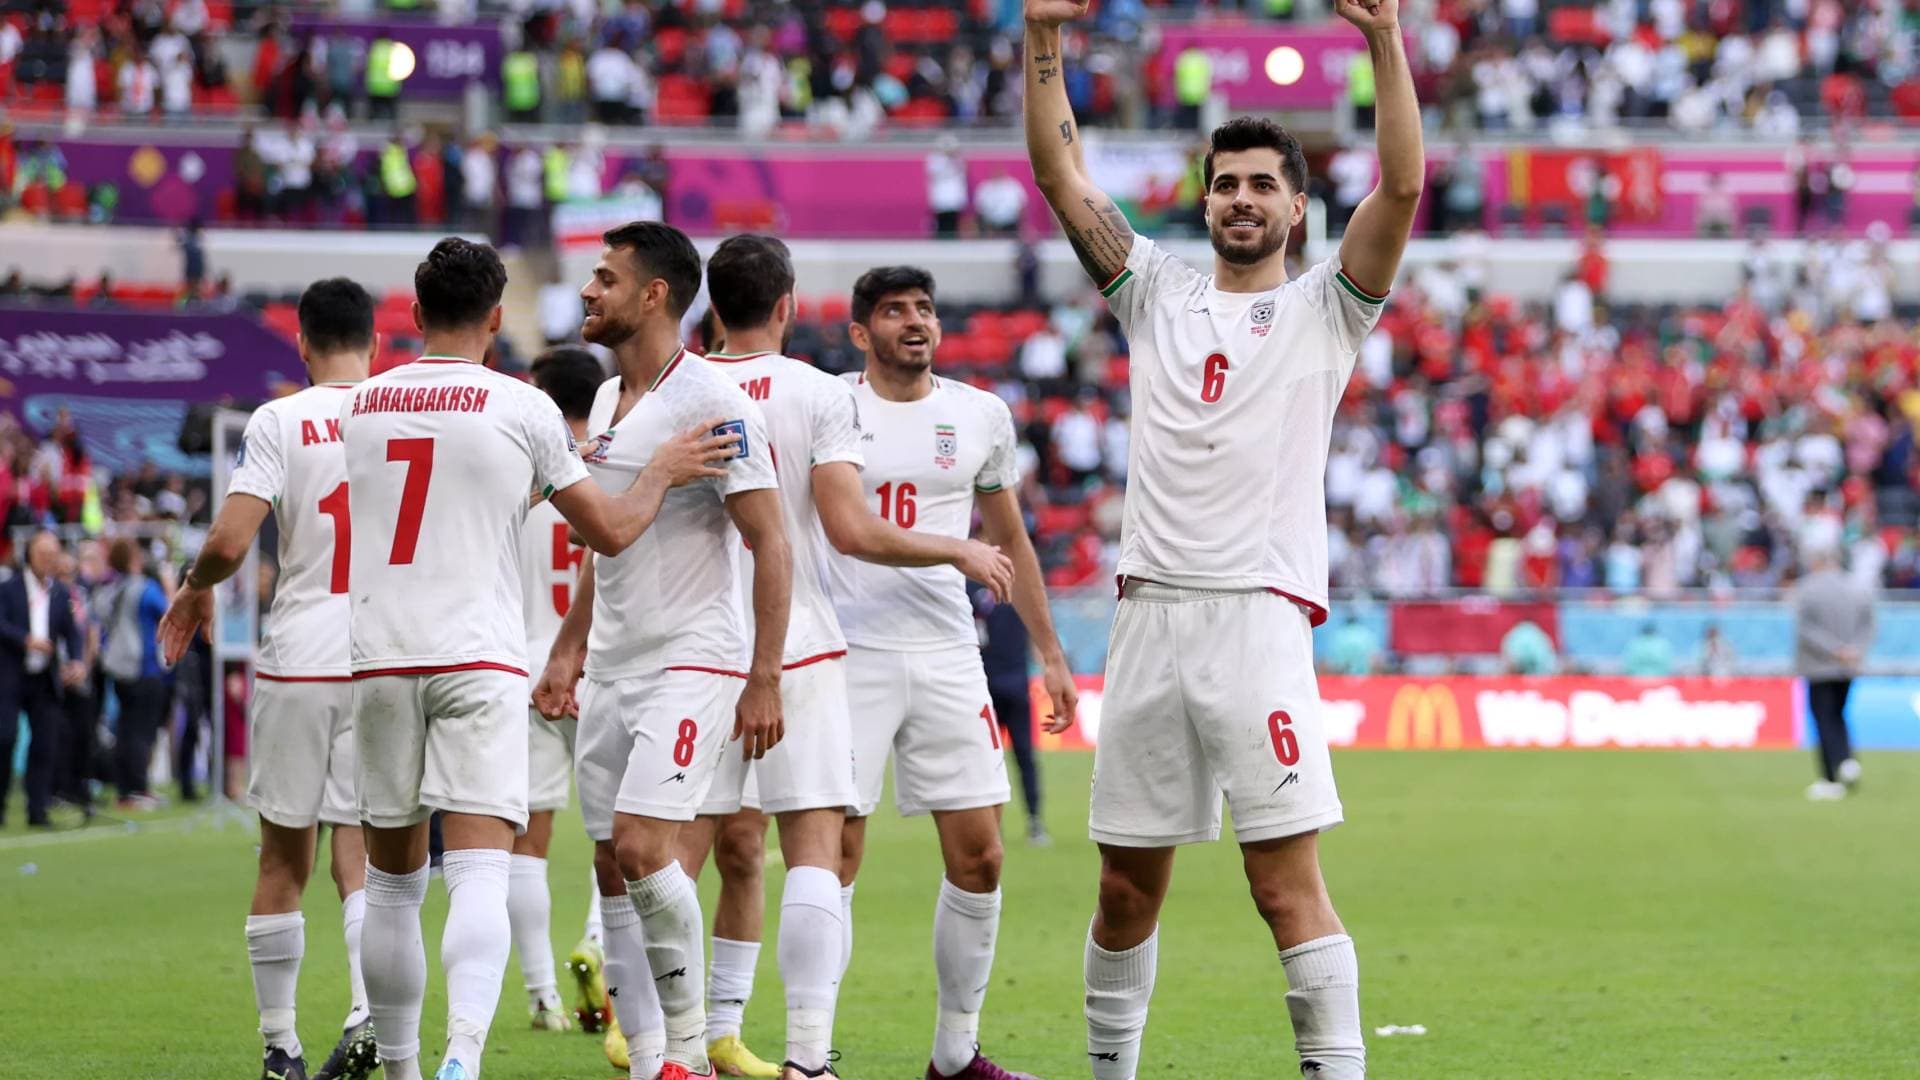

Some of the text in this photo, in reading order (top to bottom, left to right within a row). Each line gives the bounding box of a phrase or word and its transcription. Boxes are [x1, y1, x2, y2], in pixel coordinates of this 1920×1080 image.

[1201, 353, 1228, 403] 6
[386, 437, 434, 565] 7
[876, 481, 917, 529] 16
[318, 481, 351, 594] 1
[673, 718, 697, 767] 8
[1268, 710, 1300, 766] 6
